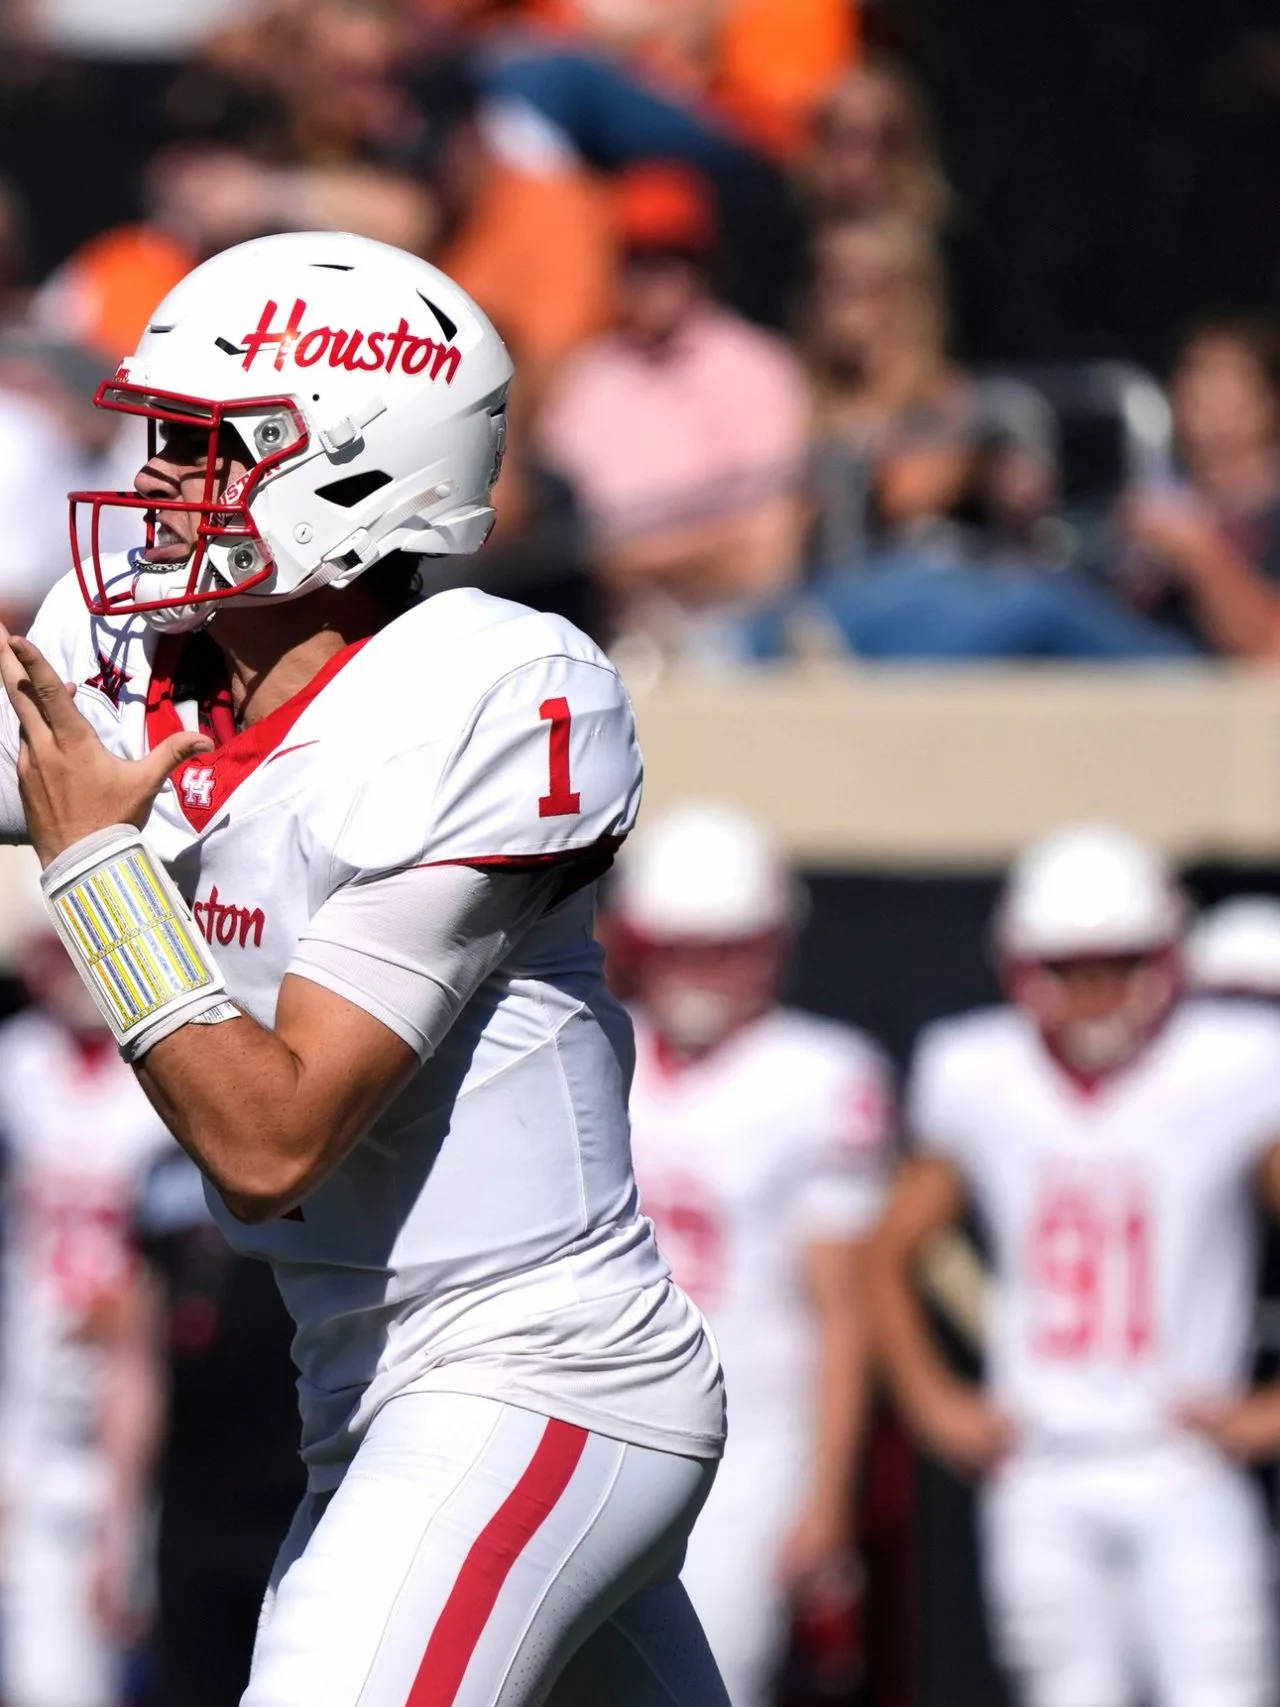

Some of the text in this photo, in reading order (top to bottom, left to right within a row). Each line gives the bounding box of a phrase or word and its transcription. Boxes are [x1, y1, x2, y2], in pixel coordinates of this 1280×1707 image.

[241, 298, 463, 386] Houston
[181, 763, 217, 809] UH
[537, 696, 581, 819] 1
